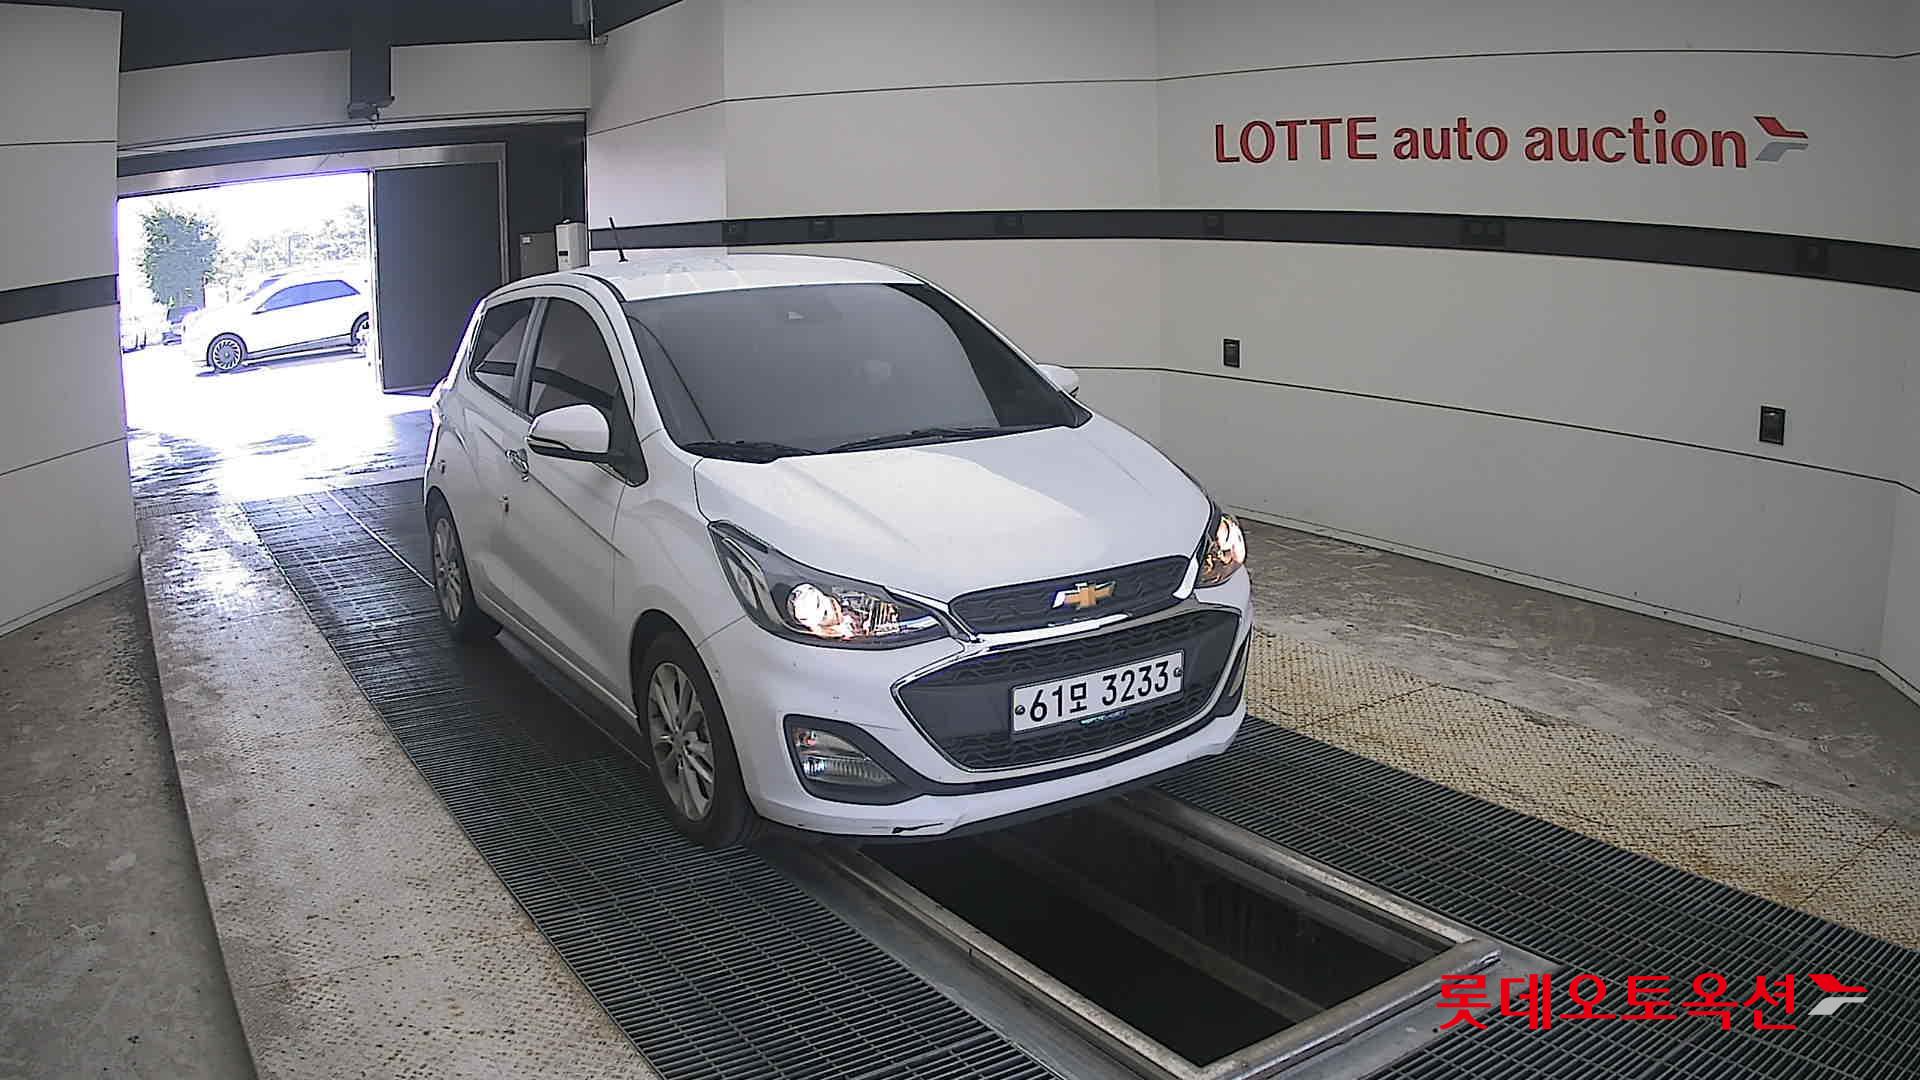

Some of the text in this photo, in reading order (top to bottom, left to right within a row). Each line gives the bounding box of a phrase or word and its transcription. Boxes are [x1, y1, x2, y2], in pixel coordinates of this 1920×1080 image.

[1215, 109, 1747, 168] LOTTE auto auction
[1029, 682, 1088, 722] 61모
[1101, 660, 1169, 706] 3233
